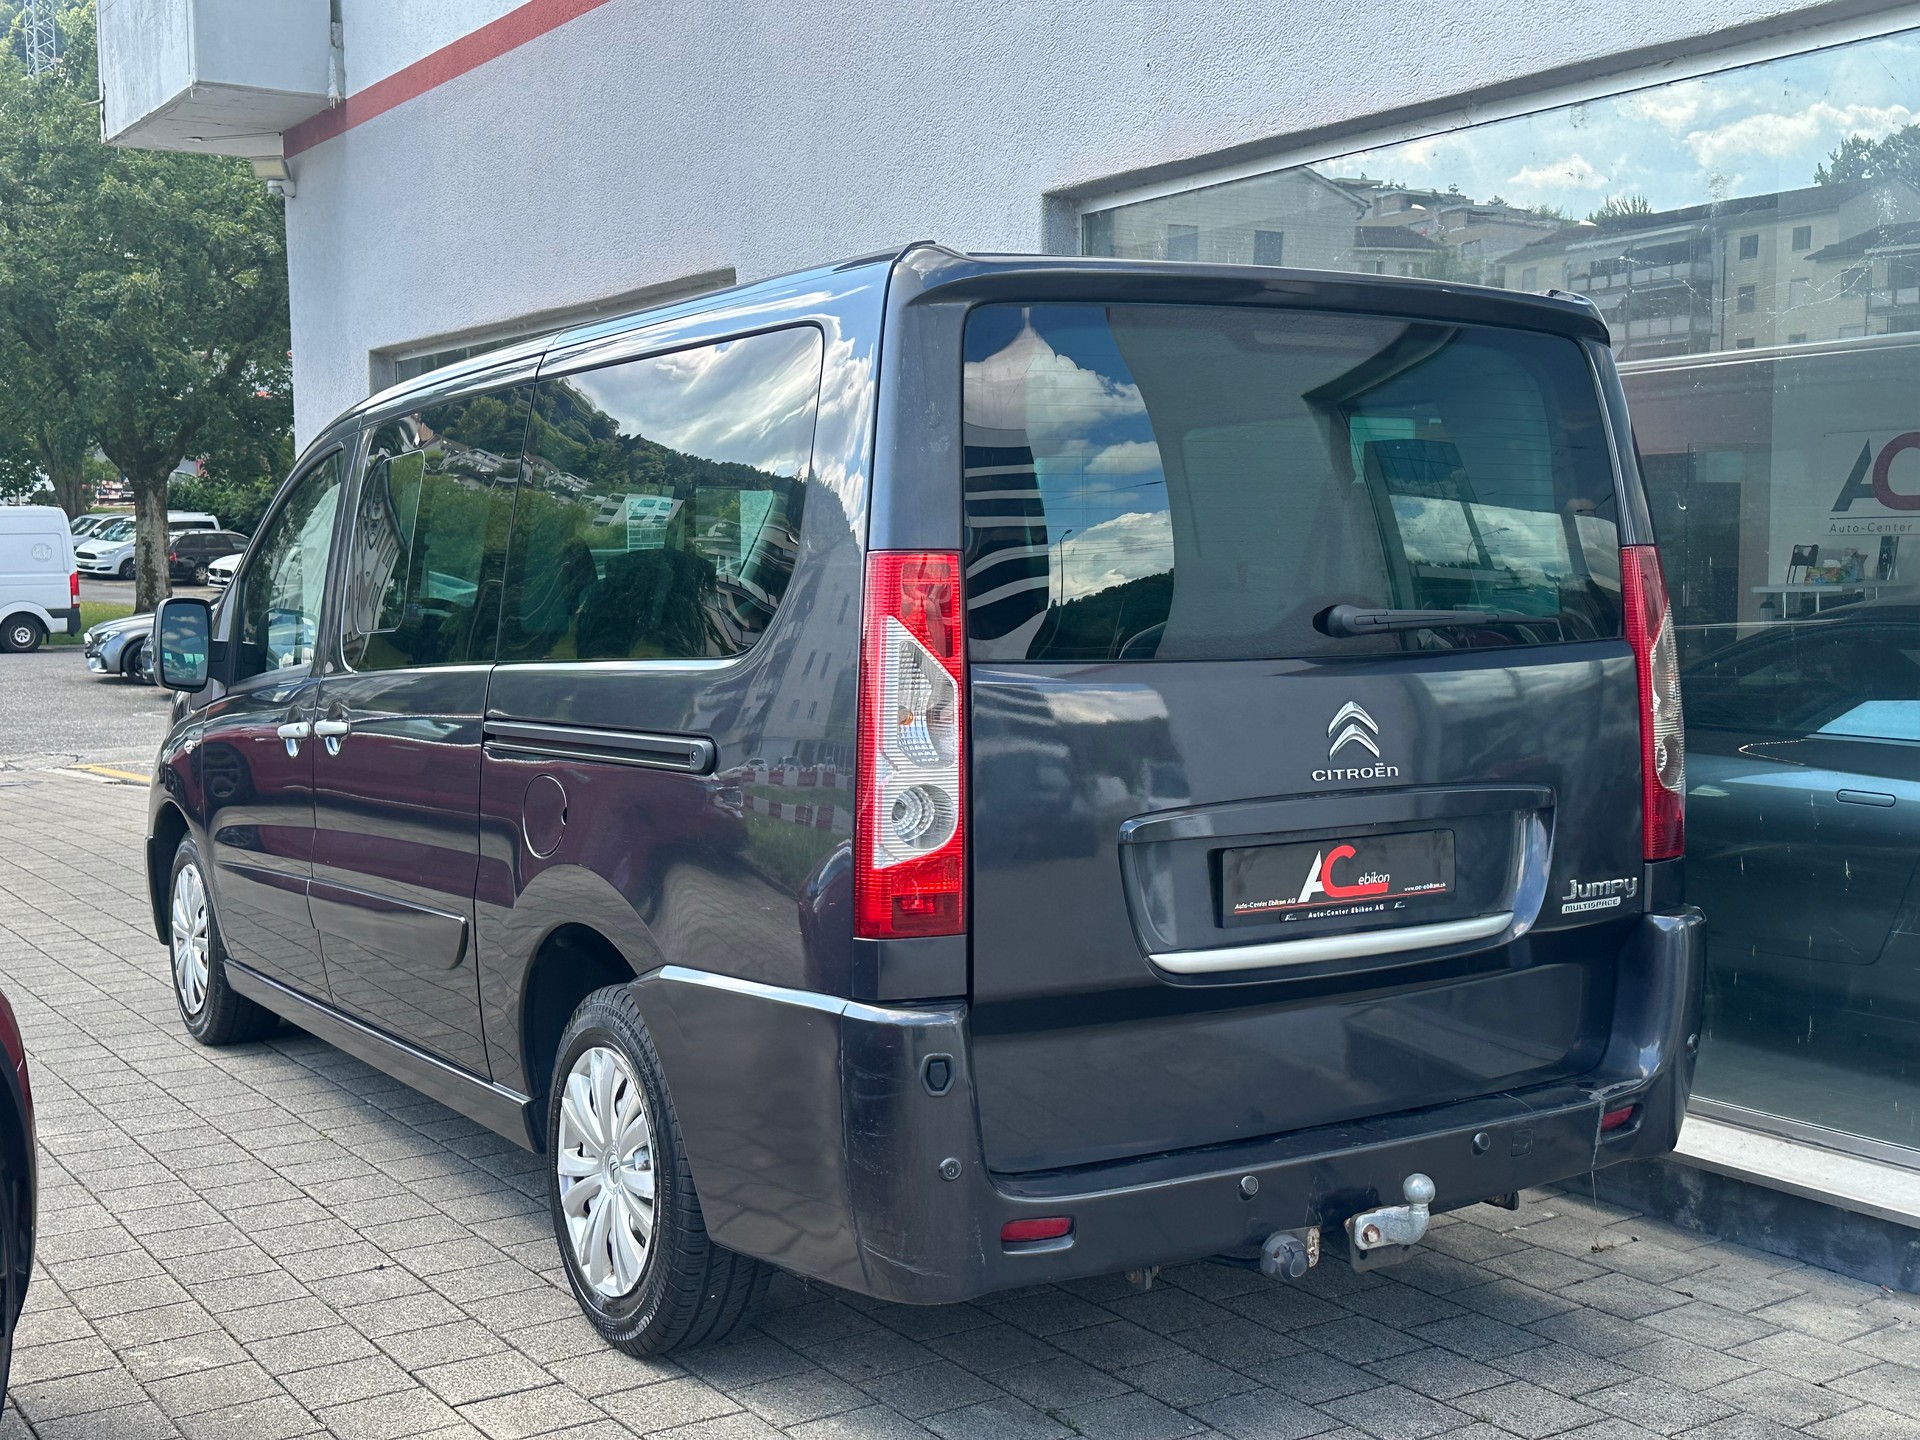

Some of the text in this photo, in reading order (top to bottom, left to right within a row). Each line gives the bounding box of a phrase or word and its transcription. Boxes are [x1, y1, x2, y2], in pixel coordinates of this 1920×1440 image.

[1829, 522, 1913, 534] Auto-Center
[1297, 844, 1389, 903] AC
[1358, 871, 1390, 886] ebikon
[1235, 901, 1268, 910] Auto-Center
[1286, 897, 1296, 905] AG
[1308, 903, 1385, 918] Auto-Center Ebikon AG
[1565, 899, 1618, 912] MULTISPACE
